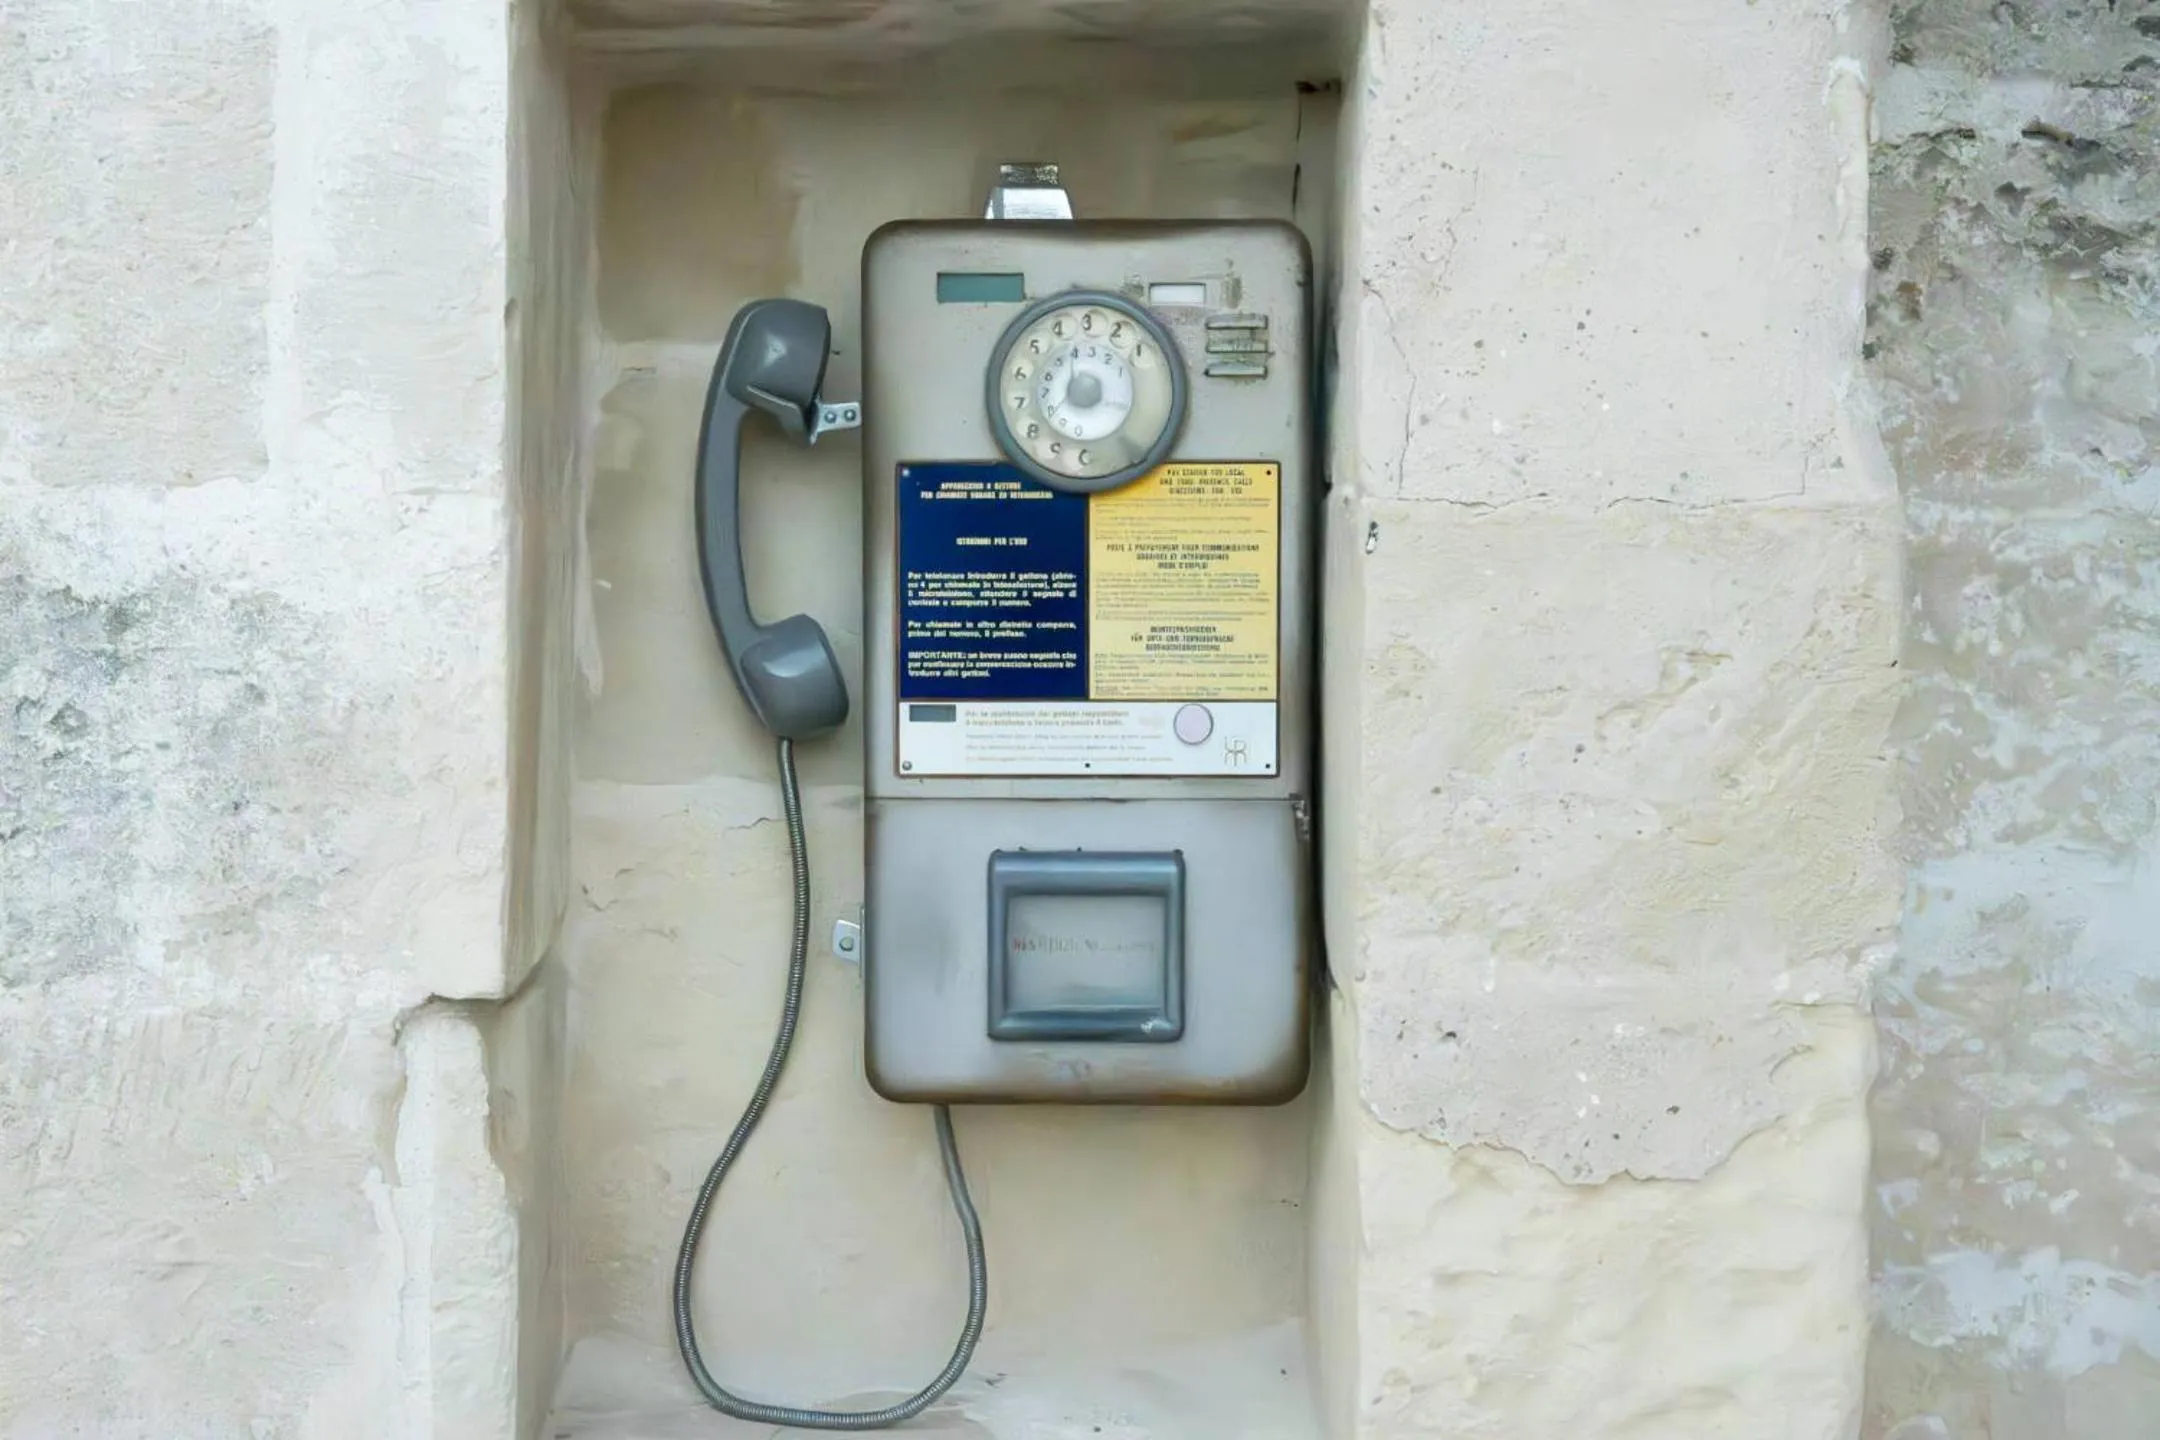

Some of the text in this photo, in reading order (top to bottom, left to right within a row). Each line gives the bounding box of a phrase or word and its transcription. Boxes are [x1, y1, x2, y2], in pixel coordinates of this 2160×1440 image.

[1052, 321, 1063, 337] 4
[1082, 314, 1092, 331] 3
[1111, 322, 1122, 338] 2
[1030, 340, 1040, 355] 5
[1136, 344, 1142, 357] 1
[1015, 367, 1026, 380] 6
[1014, 397, 1025, 409] 7
[1027, 423, 1039, 440] 8
[908, 572, 922, 581] Per
